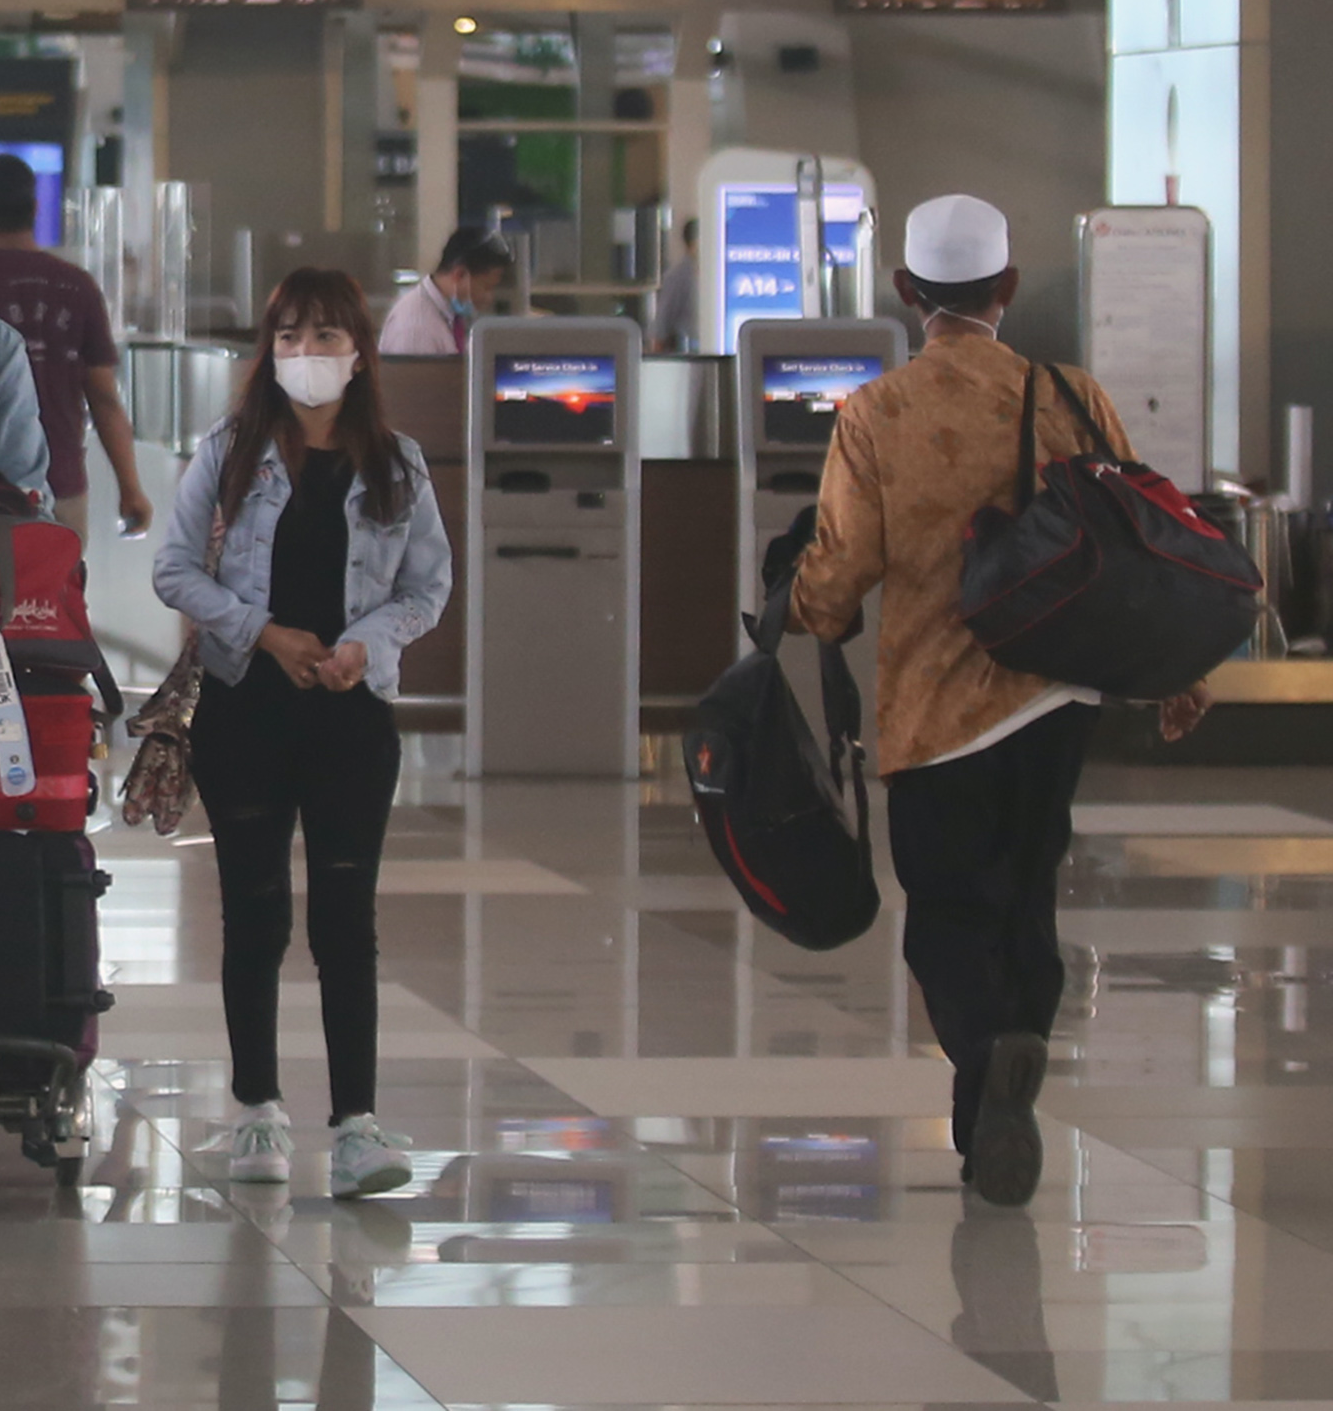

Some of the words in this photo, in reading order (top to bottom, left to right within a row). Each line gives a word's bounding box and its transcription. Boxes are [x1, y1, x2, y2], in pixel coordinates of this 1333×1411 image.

[738, 276, 779, 297] A14
[532, 363, 561, 372] Service
[799, 363, 828, 373] Service
